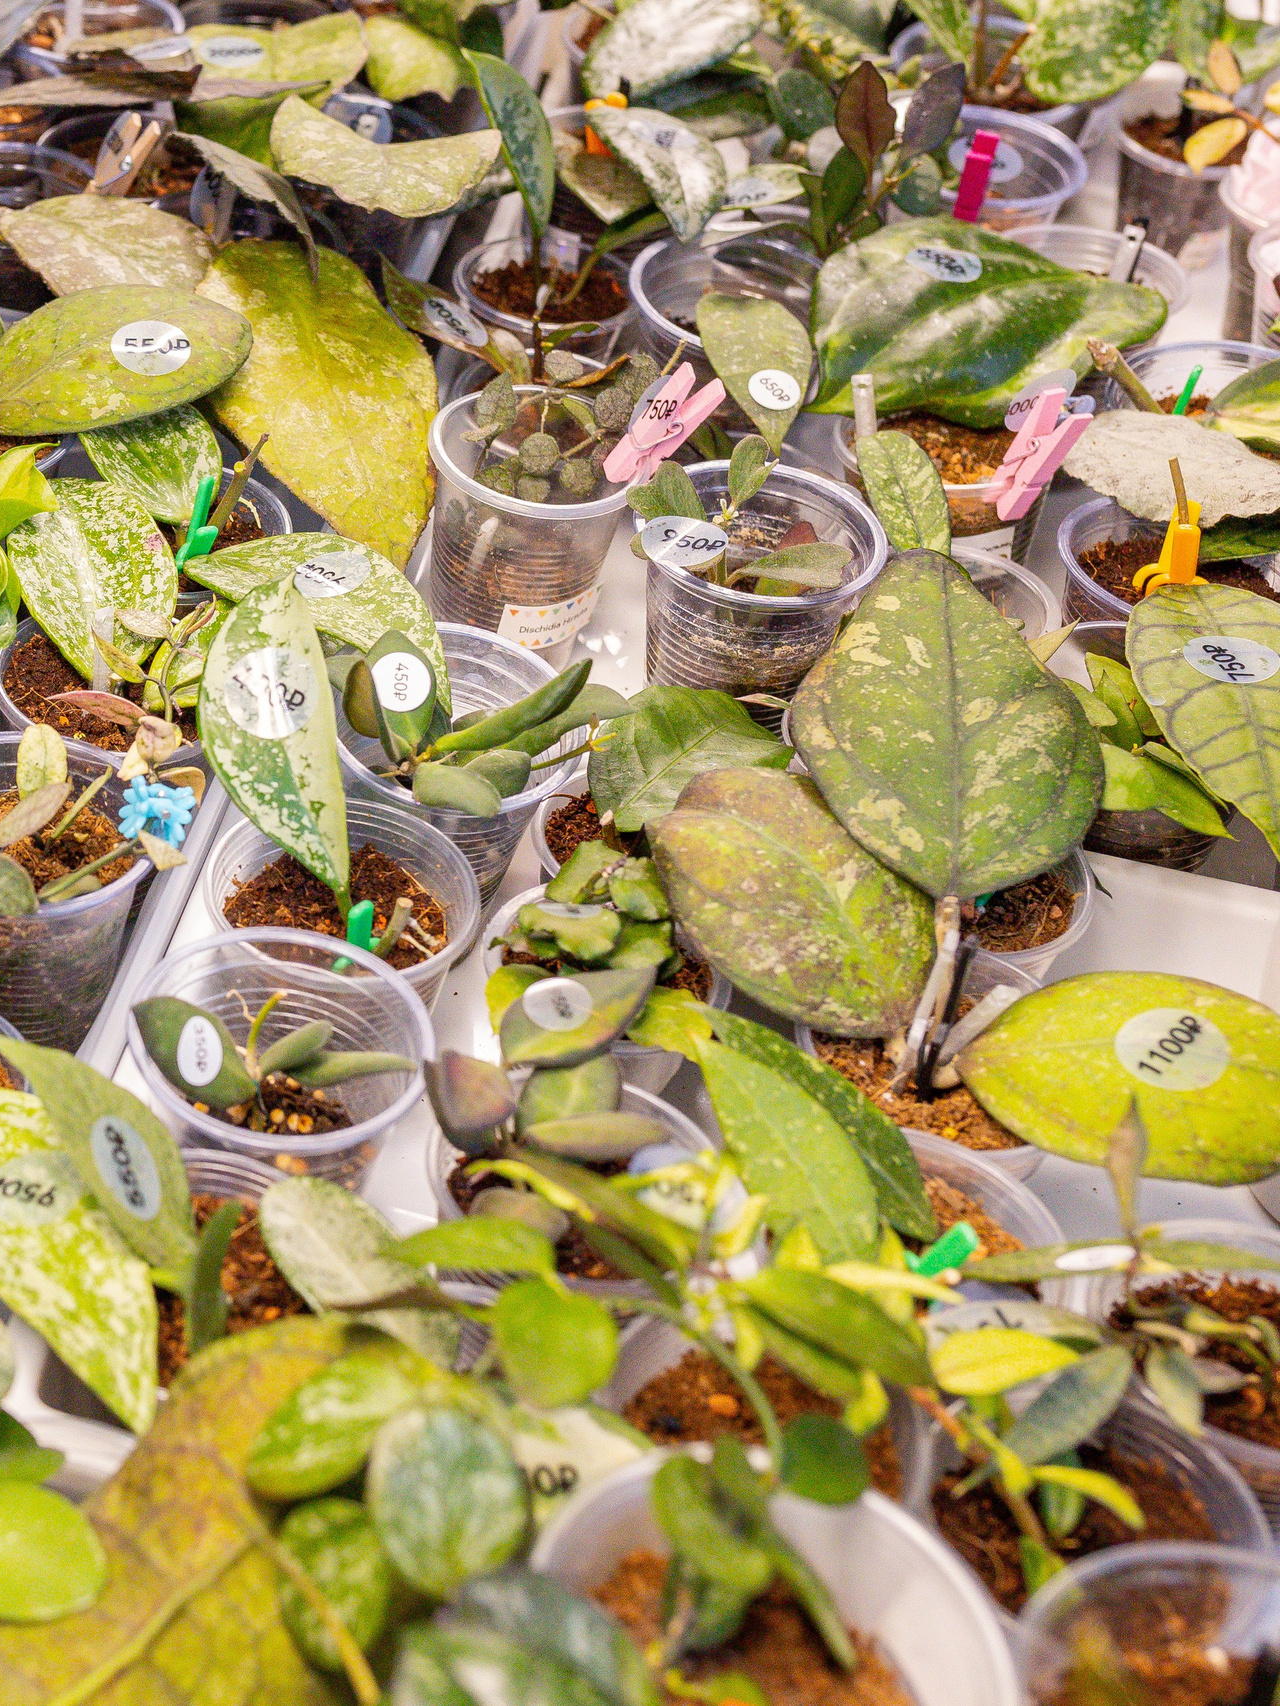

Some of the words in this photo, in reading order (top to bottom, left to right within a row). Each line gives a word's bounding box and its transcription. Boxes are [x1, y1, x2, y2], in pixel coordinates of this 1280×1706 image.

[124, 337, 190, 354] 550₽
[759, 376, 791, 403] 650₽
[641, 399, 678, 420] 750₽
[662, 528, 726, 552] 950₽
[518, 620, 561, 635] Dischidia
[1202, 643, 1256, 682] 750₽
[393, 662, 409, 702] 450₽
[1138, 1016, 1202, 1076] 1100₽
